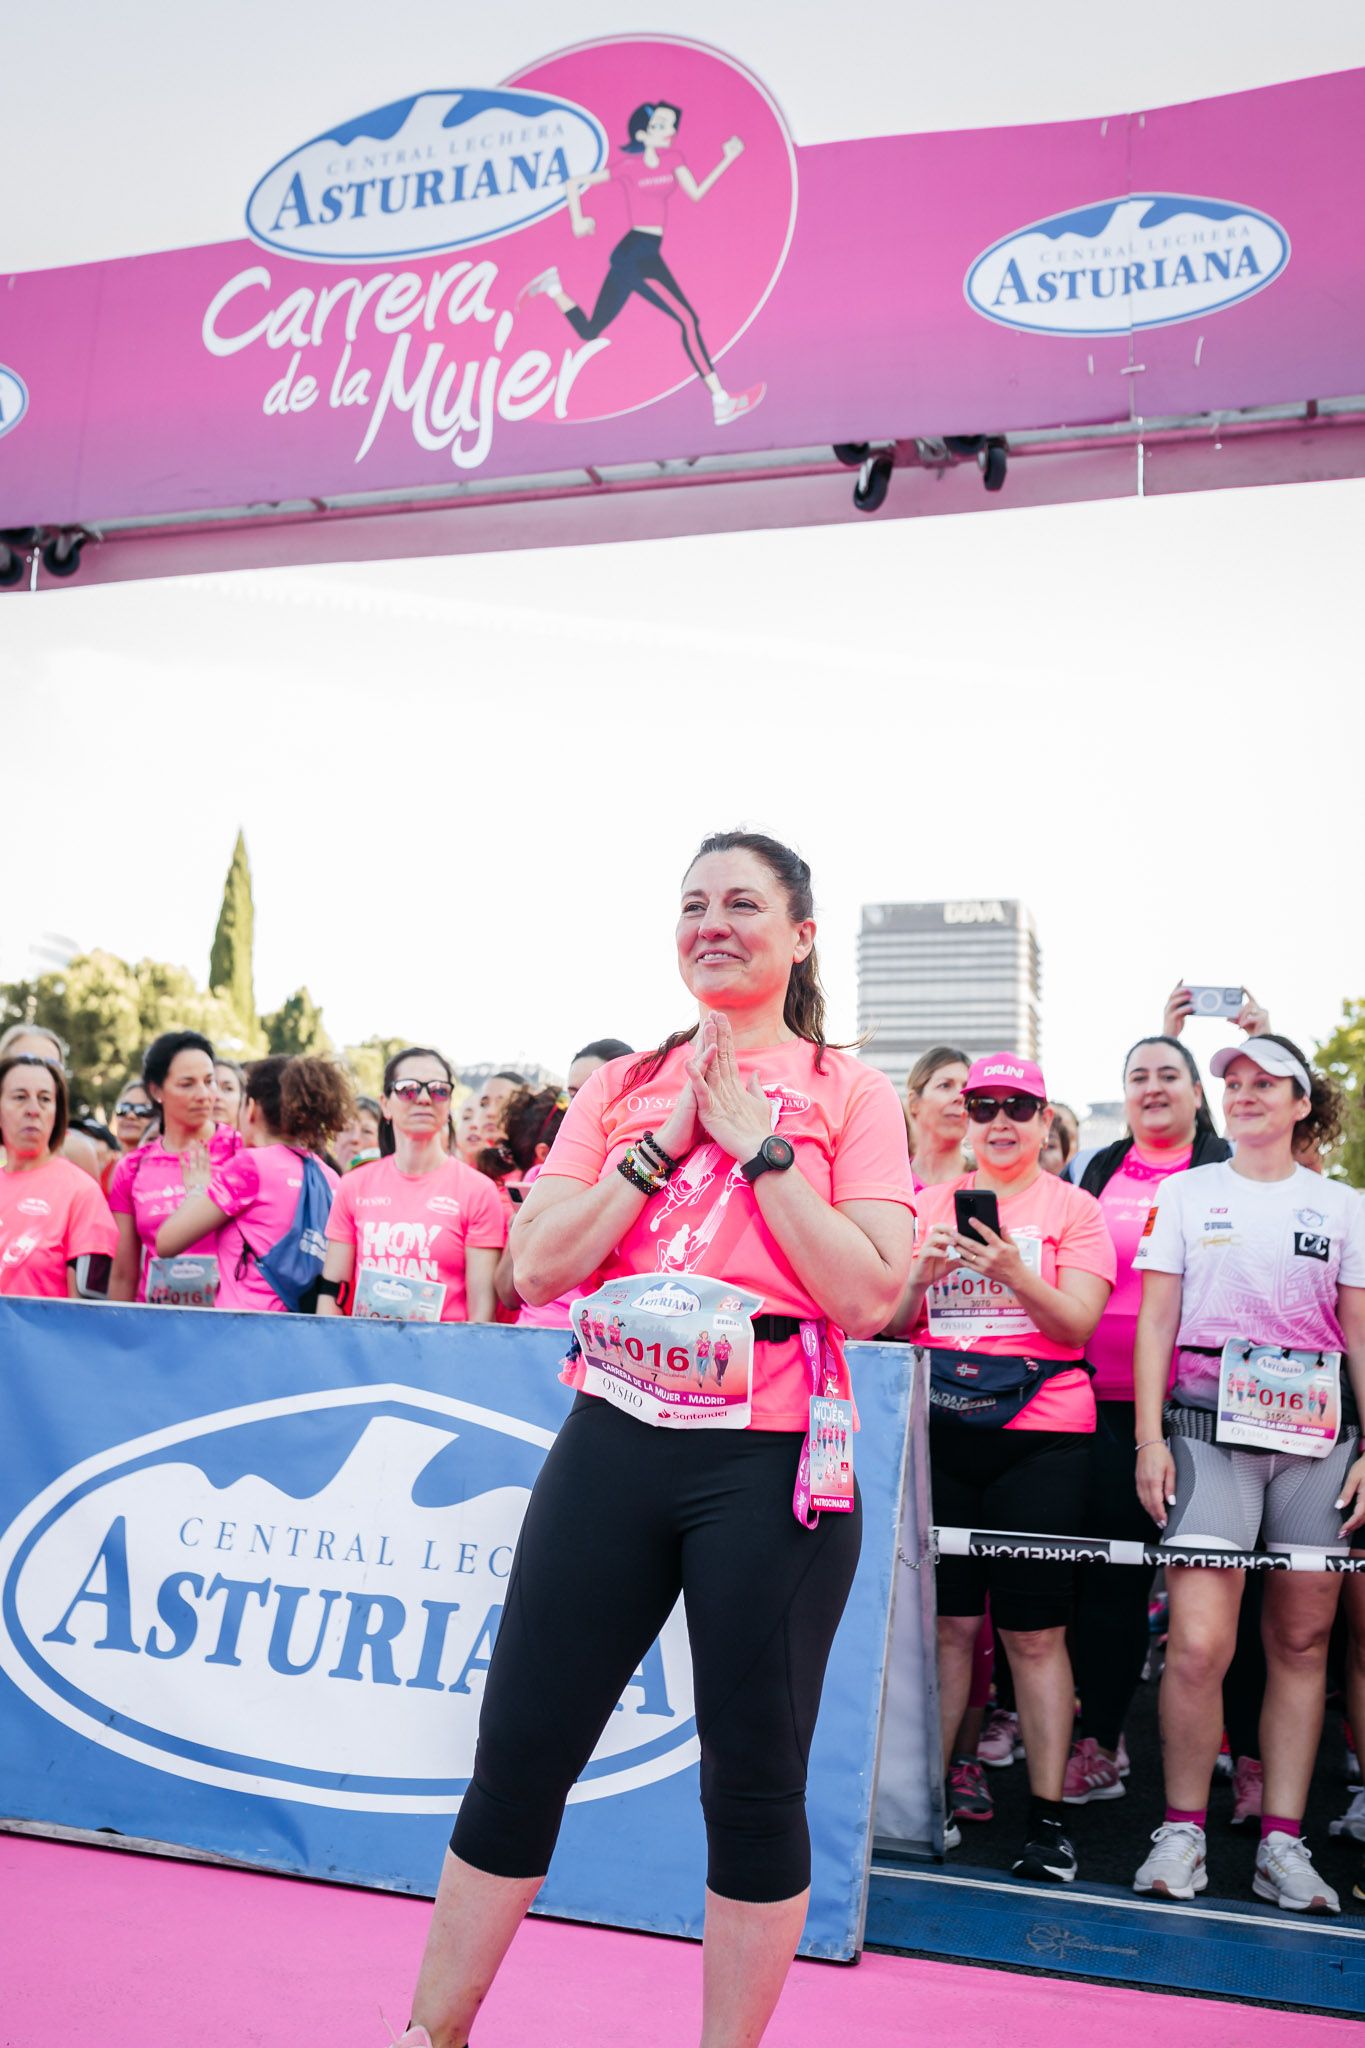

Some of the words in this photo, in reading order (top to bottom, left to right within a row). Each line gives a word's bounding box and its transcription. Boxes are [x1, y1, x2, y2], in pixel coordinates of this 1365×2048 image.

[327, 144, 437, 175] CENTRAL
[450, 122, 566, 156] LECHERA
[269, 146, 571, 232] ASTURIANA
[1040, 244, 1136, 264] CENTRAL
[1148, 226, 1251, 251] LECHERA
[991, 244, 1263, 307] ASTURIANA
[201, 261, 499, 356] Carrera
[262, 351, 319, 415] de
[329, 343, 370, 408] la
[355, 312, 611, 468] Mujer
[627, 1096, 680, 1112] OYSH
[961, 1279, 1003, 1295] 016
[624, 1337, 690, 1372] 016
[601, 1362, 633, 1383] CARRERA
[633, 1377, 643, 1388] DE
[643, 1381, 654, 1393] LA
[654, 1386, 681, 1402] MUJER
[688, 1394, 726, 1405] MADRID
[602, 1377, 643, 1408] OYSHO
[651, 1373, 658, 1382] 7
[673, 1409, 728, 1420] Santander
[813, 1407, 844, 1422] MUJER
[1259, 1388, 1304, 1410] 016
[813, 1497, 851, 1509] PATROCINADOR
[180, 1516, 394, 1566] CENTRAL
[43, 1515, 675, 1718] ASTURIAA
